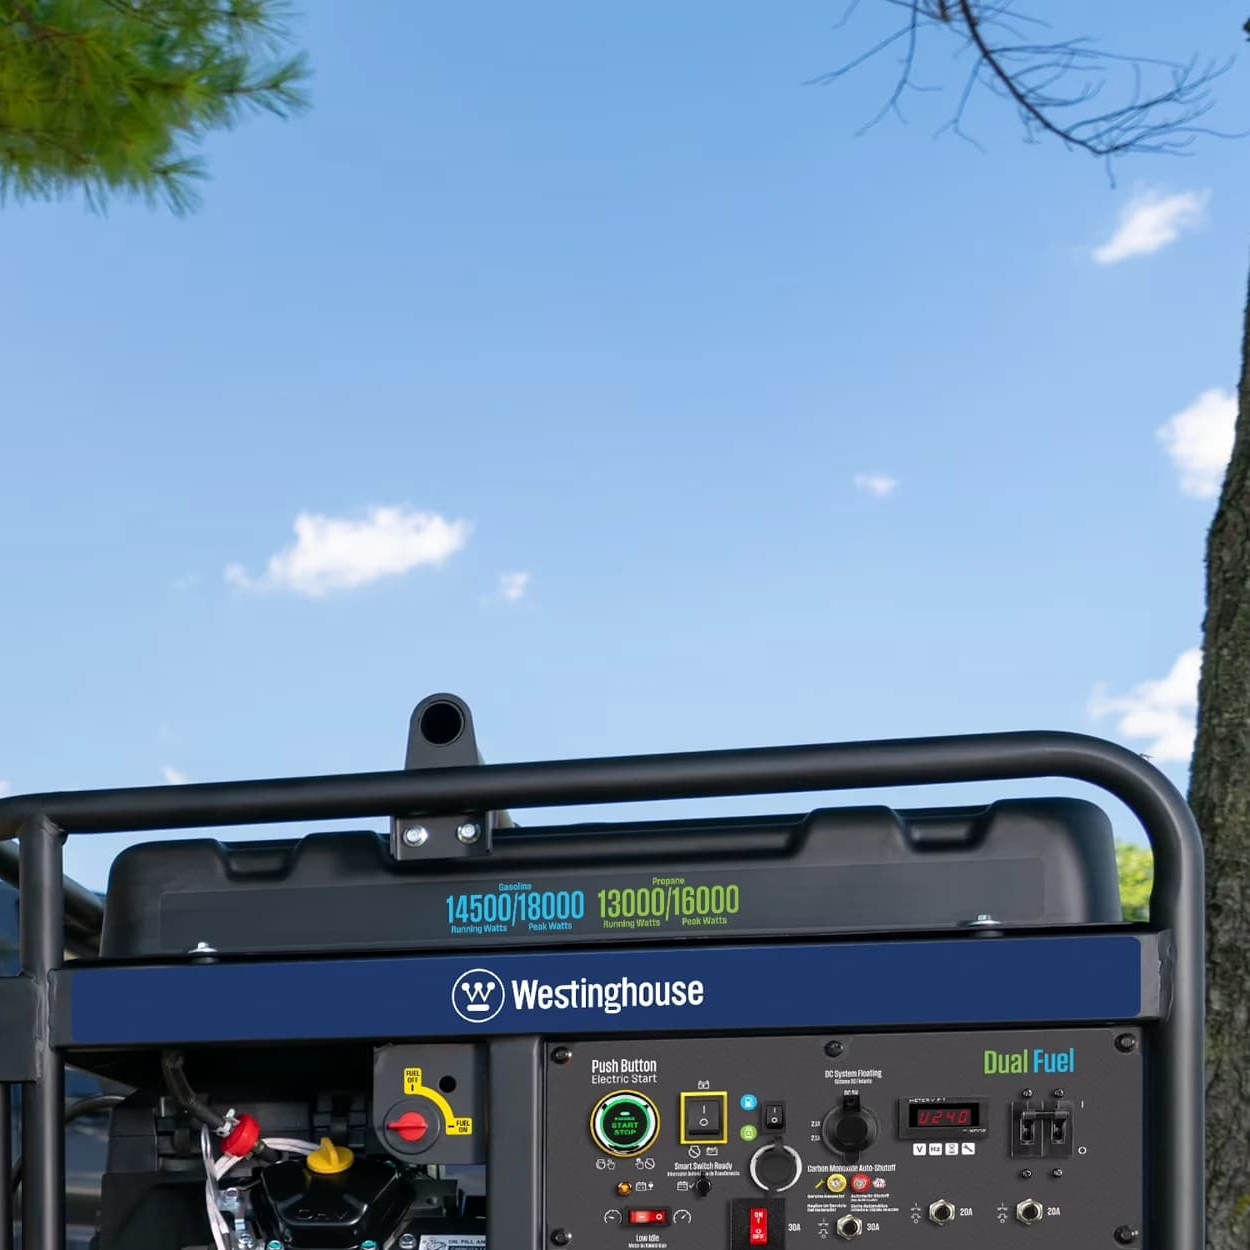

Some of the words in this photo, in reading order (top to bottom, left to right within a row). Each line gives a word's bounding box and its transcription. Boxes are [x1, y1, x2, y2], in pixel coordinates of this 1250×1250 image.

[498, 882, 532, 891] Gasoline
[652, 877, 685, 886] Propane
[597, 884, 740, 921] 13000/16000
[446, 890, 585, 927] 14500/18000
[528, 922, 547, 931] Peak
[548, 921, 573, 930] Watts
[603, 920, 635, 929] Running
[636, 919, 661, 927] Watts
[682, 918, 701, 926] Peak
[702, 916, 728, 925] Watts
[451, 925, 482, 934] Running
[483, 924, 508, 933] Watts
[511, 976, 704, 1014] Westinghouse
[592, 1060, 618, 1073] Push
[621, 1059, 657, 1072] Button
[983, 1050, 1028, 1074] Dual
[1033, 1048, 1075, 1073] Fuel
[591, 1074, 629, 1084] Electric
[631, 1074, 657, 1083] Start
[825, 1070, 833, 1078] DC
[834, 1070, 857, 1079] System
[916, 1145, 923, 1153] V
[960, 1208, 973, 1216] 20A
[1047, 1208, 1061, 1216] 20A
[788, 1223, 801, 1231] 30A
[867, 1223, 880, 1231] 30A
